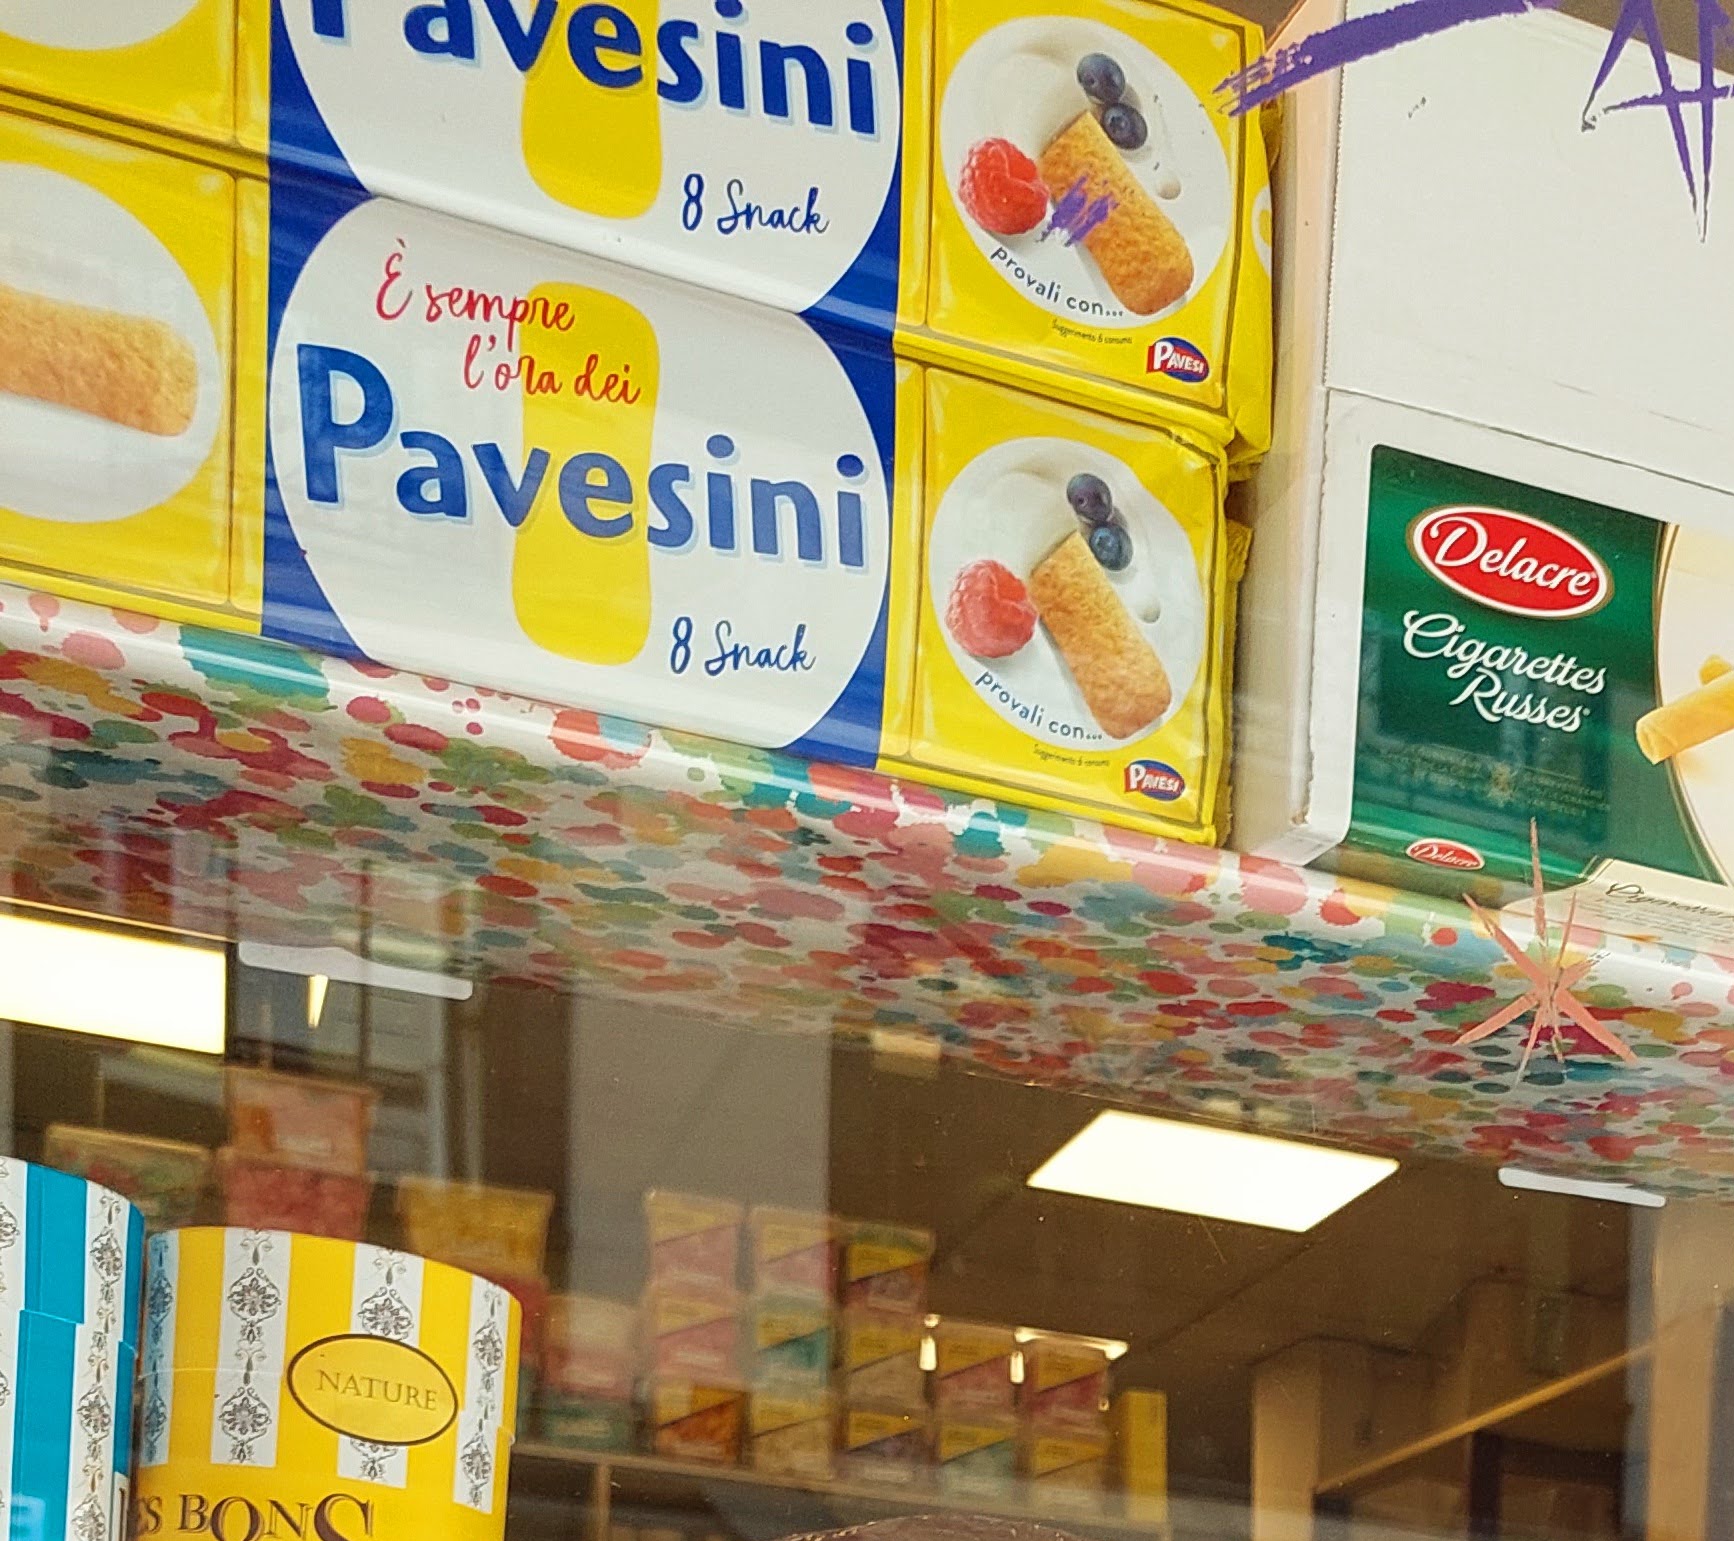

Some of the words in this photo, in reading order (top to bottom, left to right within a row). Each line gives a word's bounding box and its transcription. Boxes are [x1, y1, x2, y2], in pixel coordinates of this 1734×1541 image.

[308, 0, 879, 136] avesini
[682, 172, 705, 233] 8
[716, 177, 831, 236] Snack
[425, 281, 577, 353] sempre
[990, 245, 1062, 305] provali
[1065, 291, 1125, 319] con...
[463, 334, 564, 398] l'ora
[574, 352, 643, 406] dei
[295, 343, 868, 571] Pavesini
[1428, 516, 1596, 598] Delacre
[668, 615, 693, 676] 8
[704, 624, 818, 677] Snack
[1401, 609, 1608, 697] Cigarettes
[975, 670, 1044, 728] provali
[1047, 718, 1103, 742] con...
[1448, 675, 1587, 732] Russes
[1408, 842, 1482, 870] Delacre
[315, 1367, 439, 1414] NATURE
